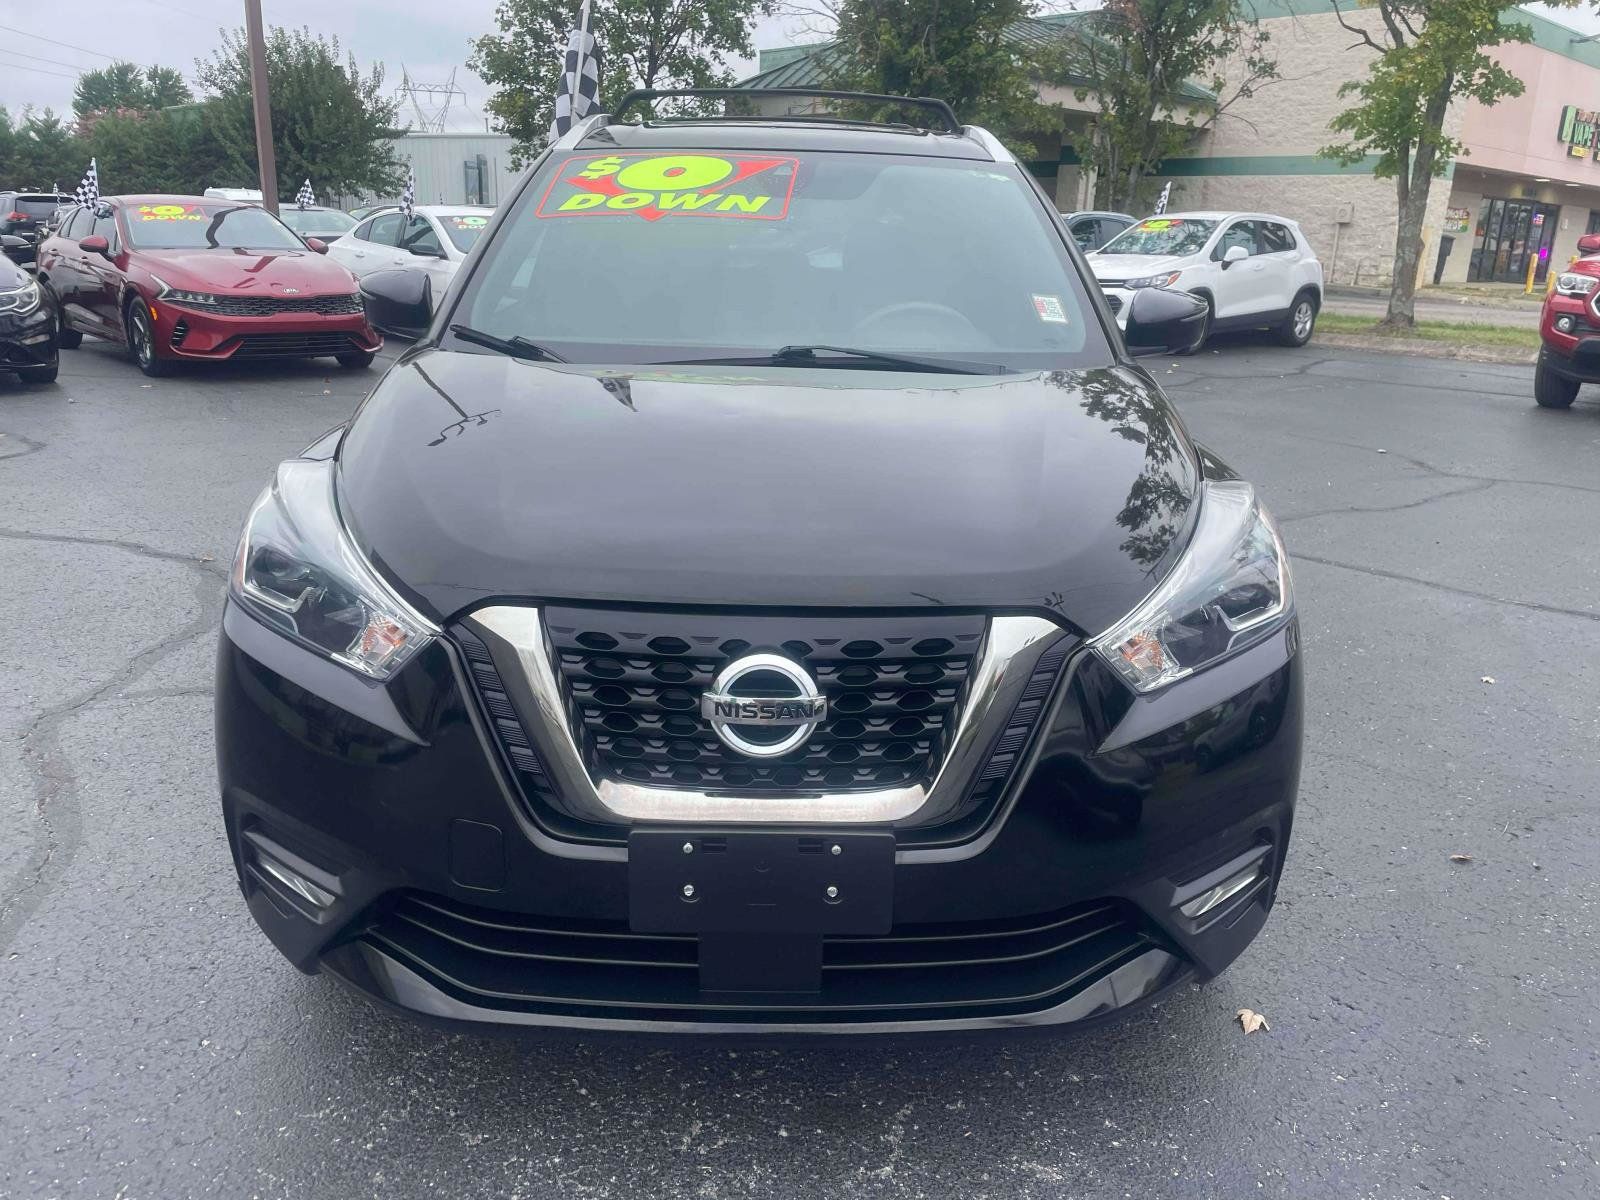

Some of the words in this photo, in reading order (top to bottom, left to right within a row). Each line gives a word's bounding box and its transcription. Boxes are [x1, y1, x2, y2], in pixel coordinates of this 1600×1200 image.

[577, 155, 733, 191] $0
[557, 192, 772, 213] DOWN
[714, 701, 814, 720] NISSAN
